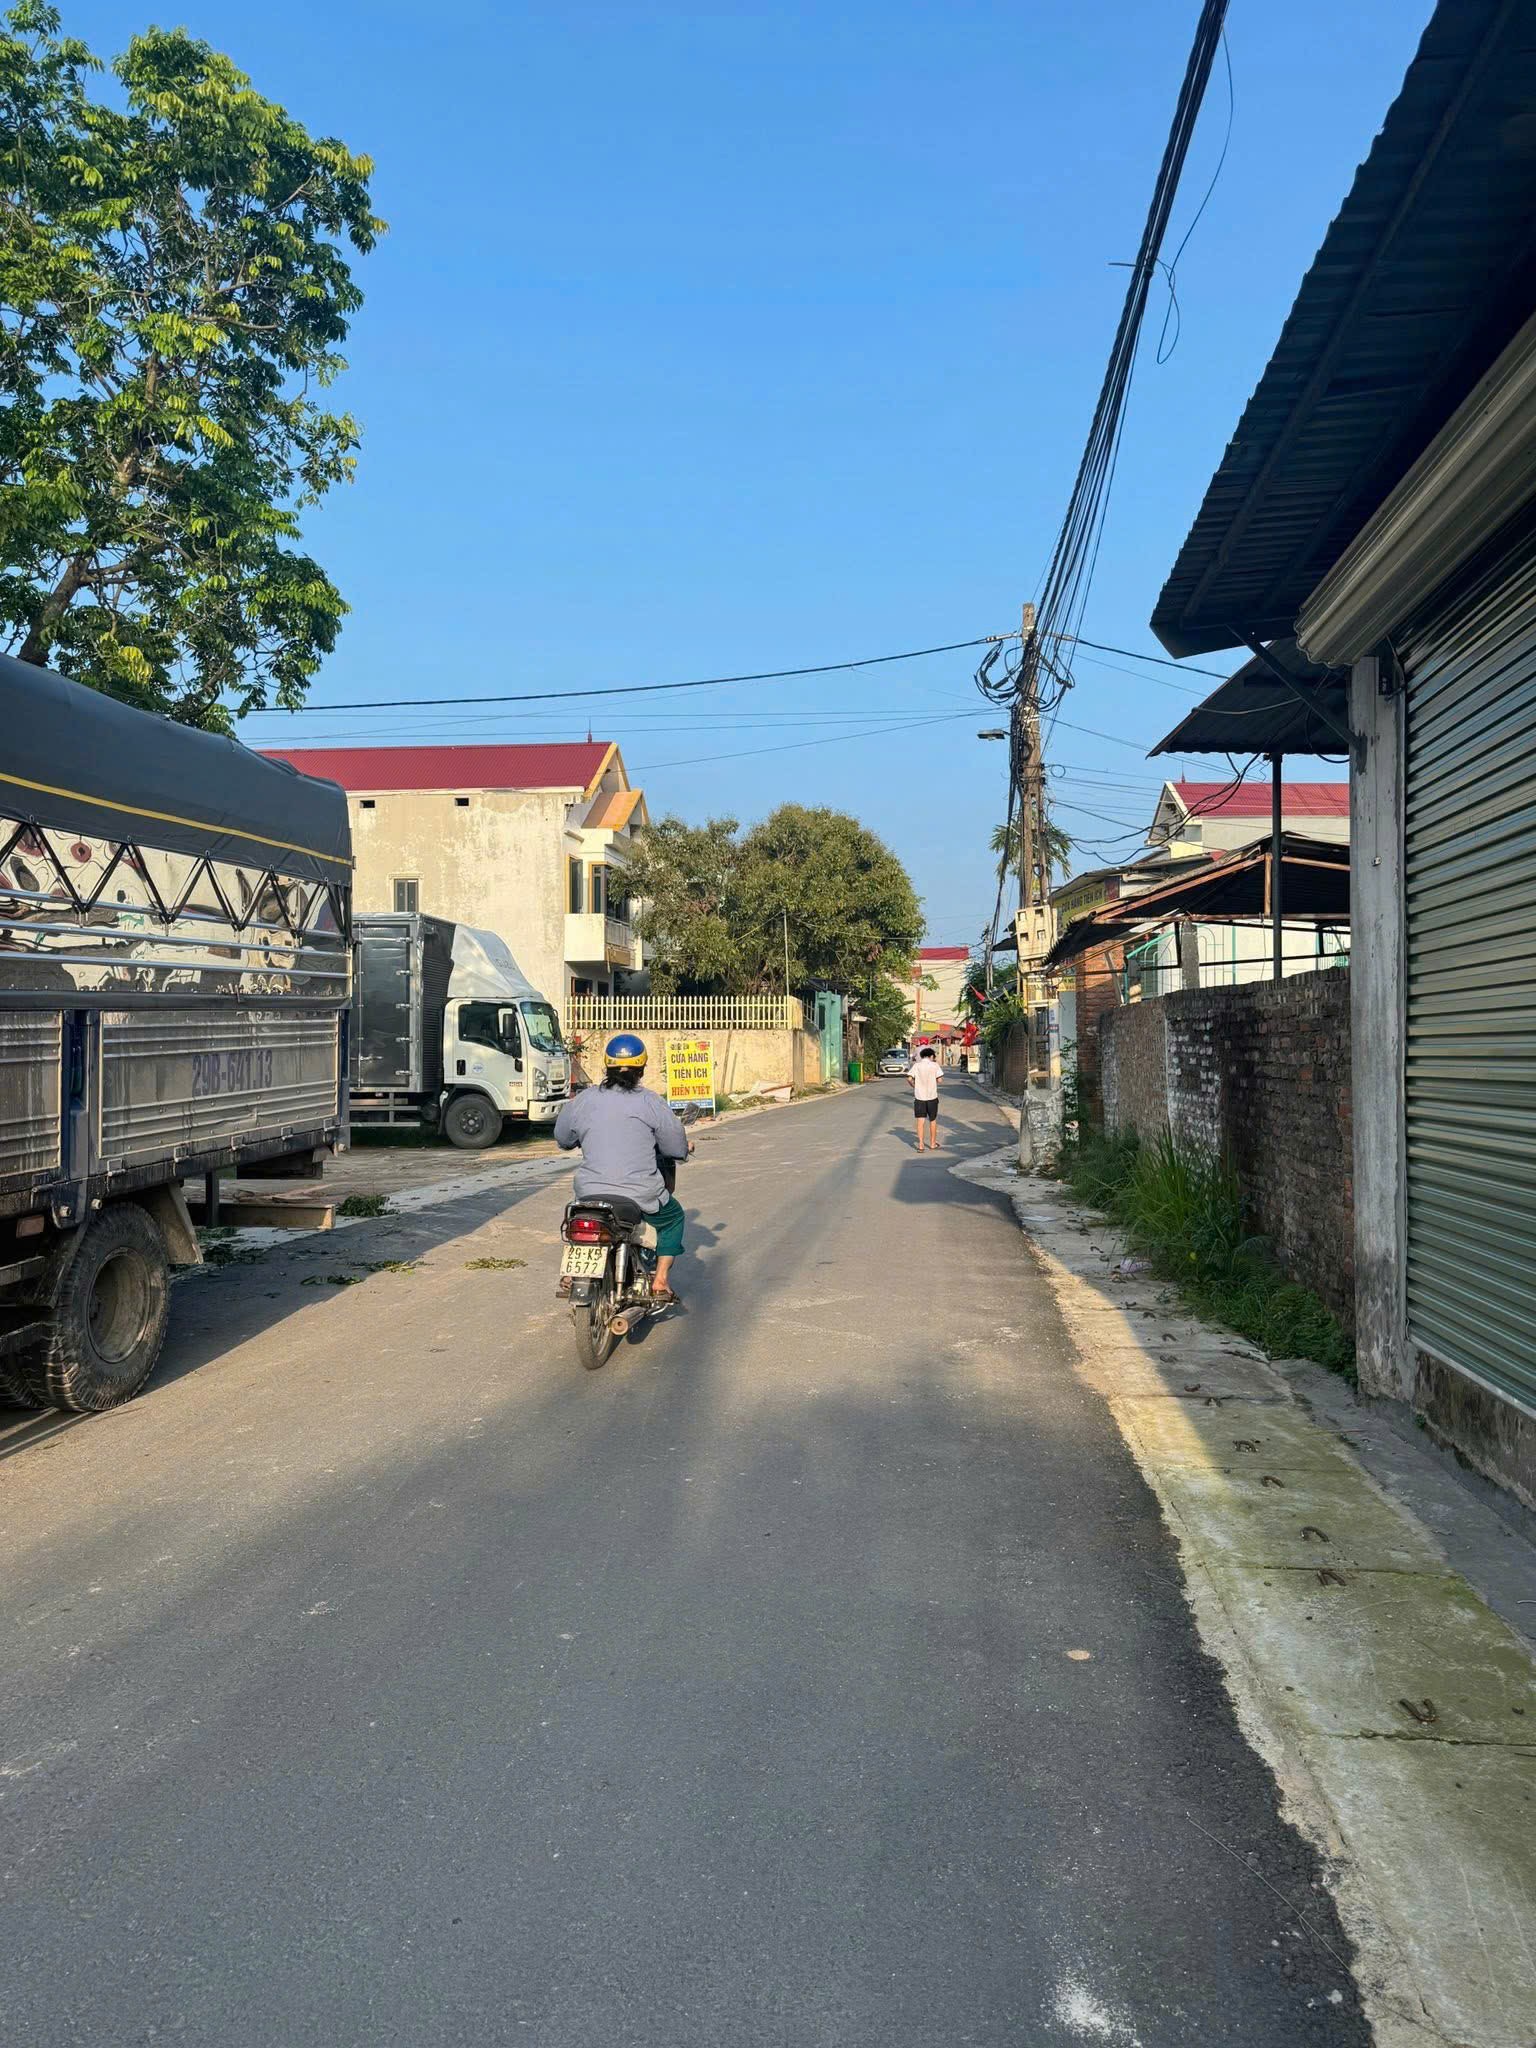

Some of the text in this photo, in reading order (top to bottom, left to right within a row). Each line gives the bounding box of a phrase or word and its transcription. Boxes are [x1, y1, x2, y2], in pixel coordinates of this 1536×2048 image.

[671, 1049, 708, 1064] CỬA HÀNG
[192, 1049, 273, 1099] 29B-641.13
[673, 1067, 692, 1081] TIỆN
